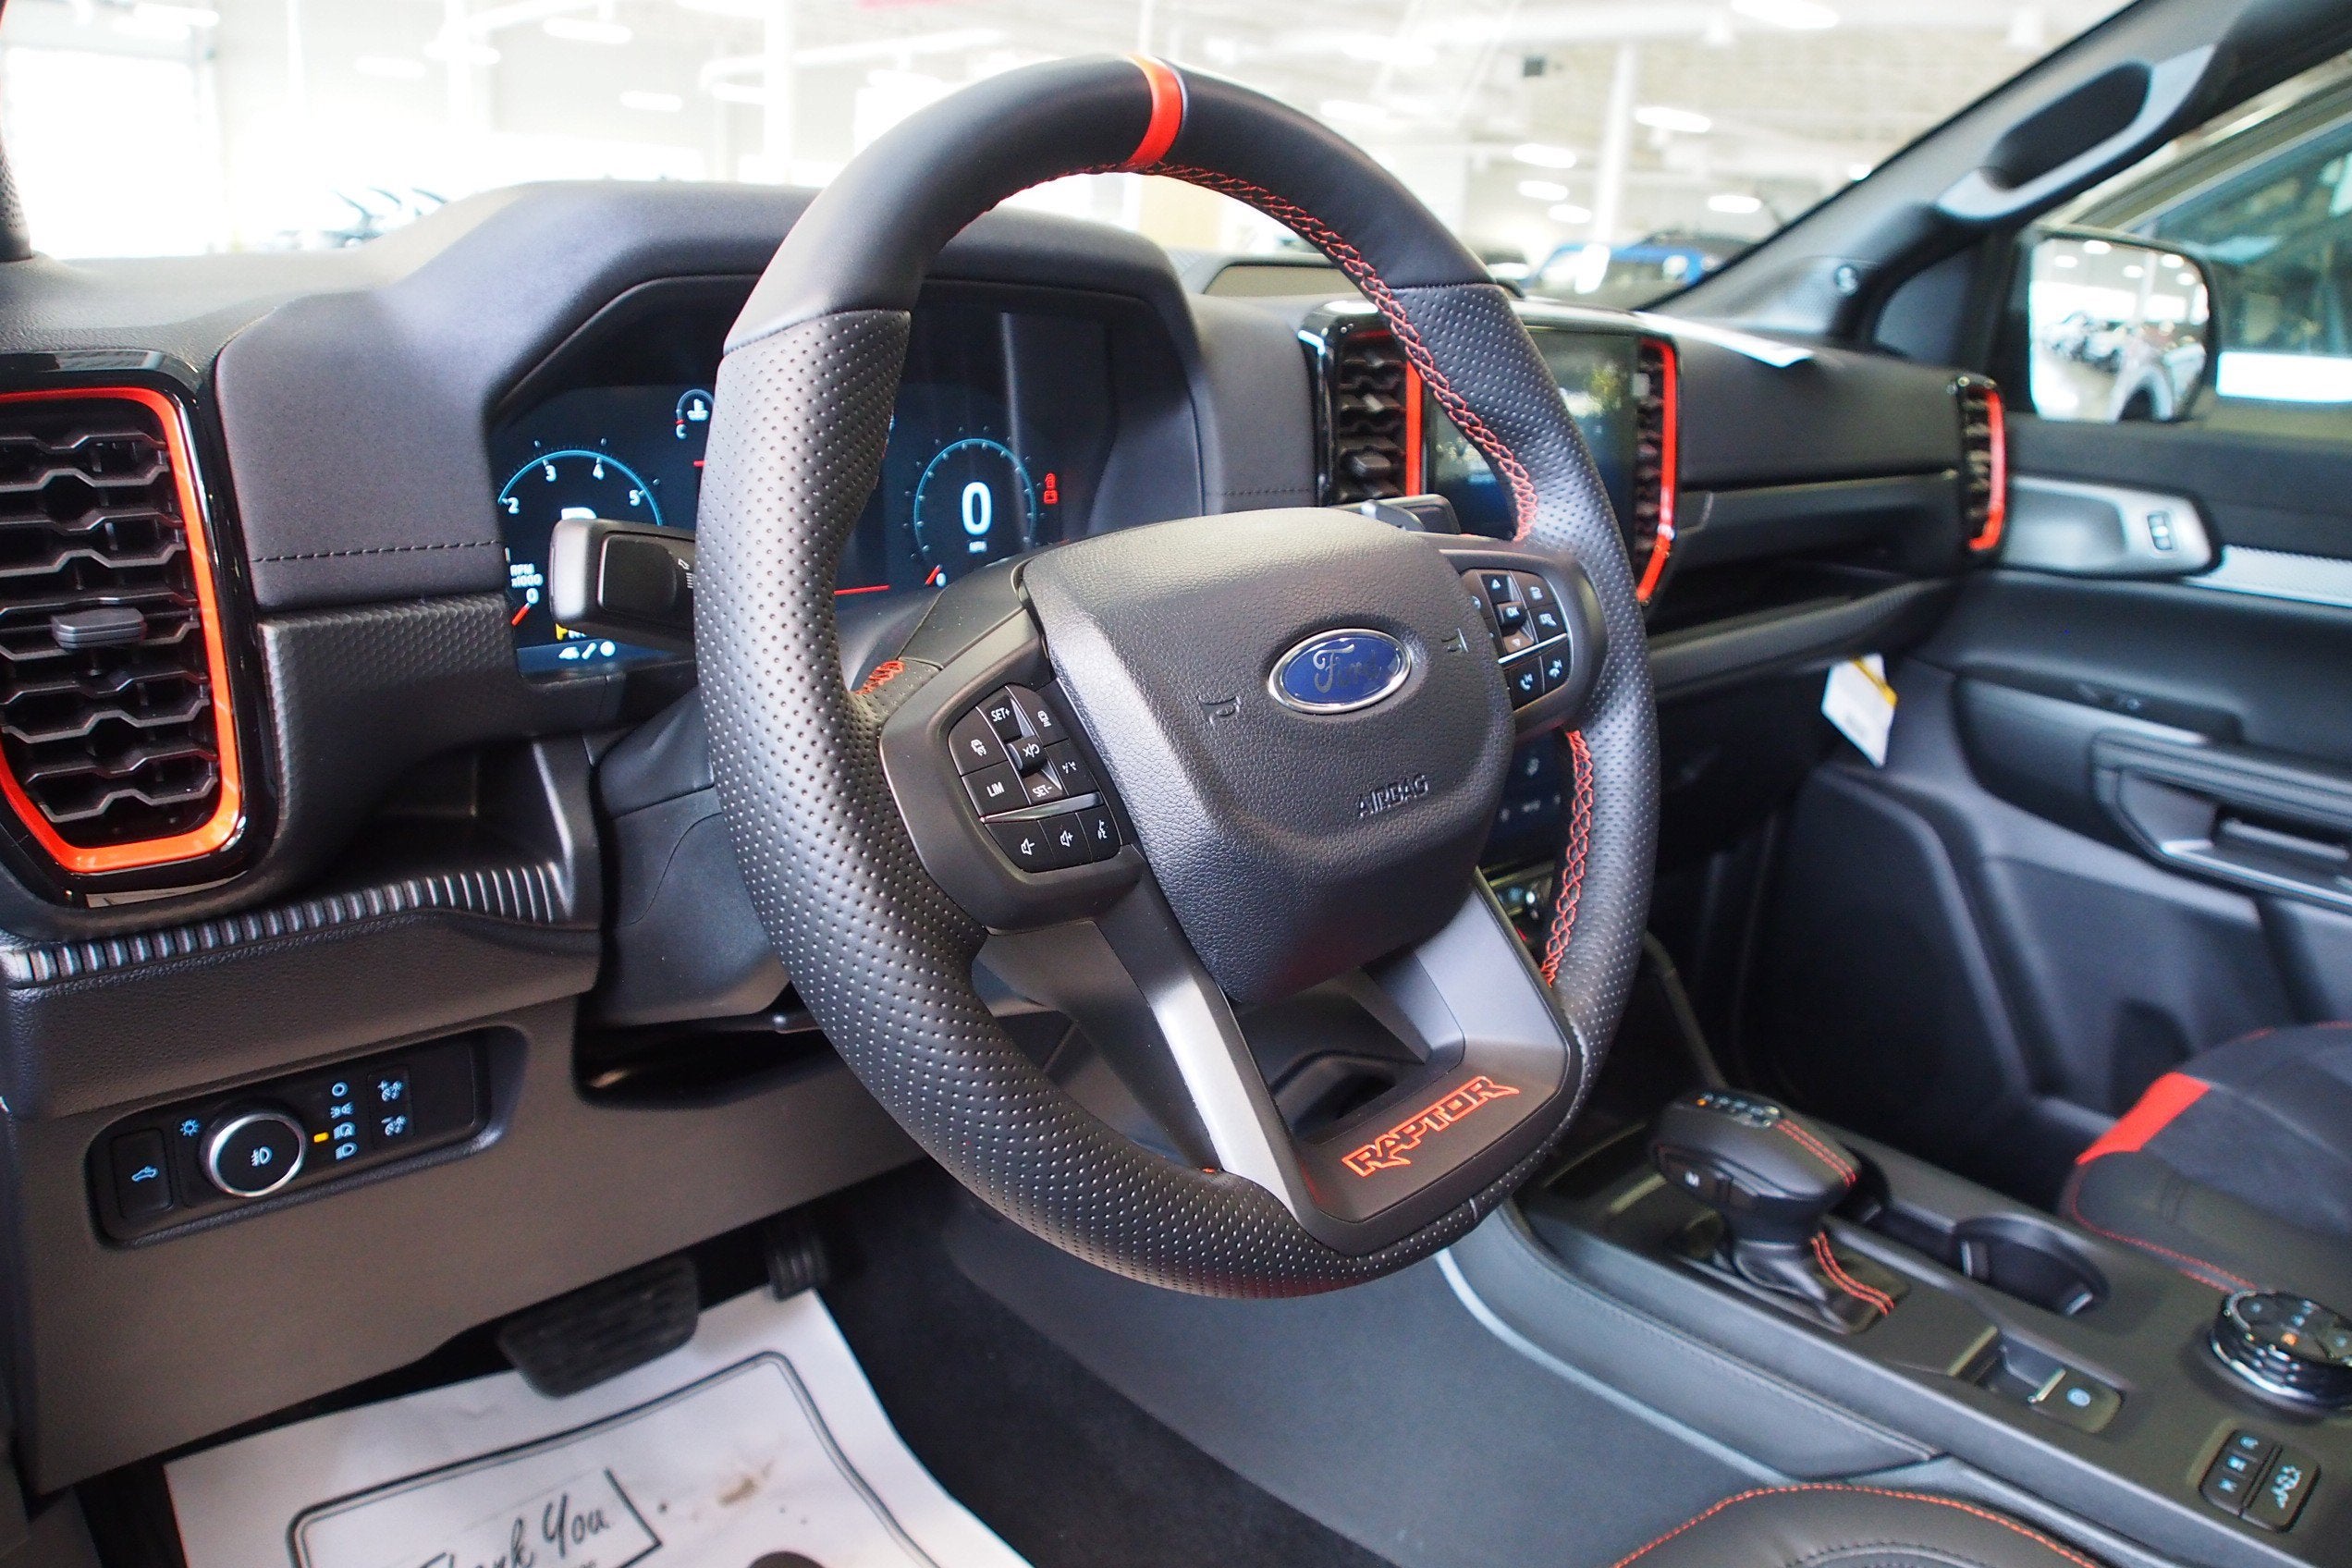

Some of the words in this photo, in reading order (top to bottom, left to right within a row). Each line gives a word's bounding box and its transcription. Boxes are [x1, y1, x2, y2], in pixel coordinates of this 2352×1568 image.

[676, 423, 688, 439] C
[545, 465, 557, 483] 3
[593, 464, 606, 481] 4
[508, 496, 521, 514] 2
[629, 489, 641, 507] 5
[962, 482, 992, 535] 0
[525, 588, 539, 604] 0
[1506, 606, 1520, 618] OK
[1313, 644, 1385, 693] Ford
[986, 781, 1005, 797] LIM
[1358, 773, 1429, 817] AIRBAG
[1341, 1075, 1521, 1177] RAPTOR
[541, 1492, 610, 1558] You
